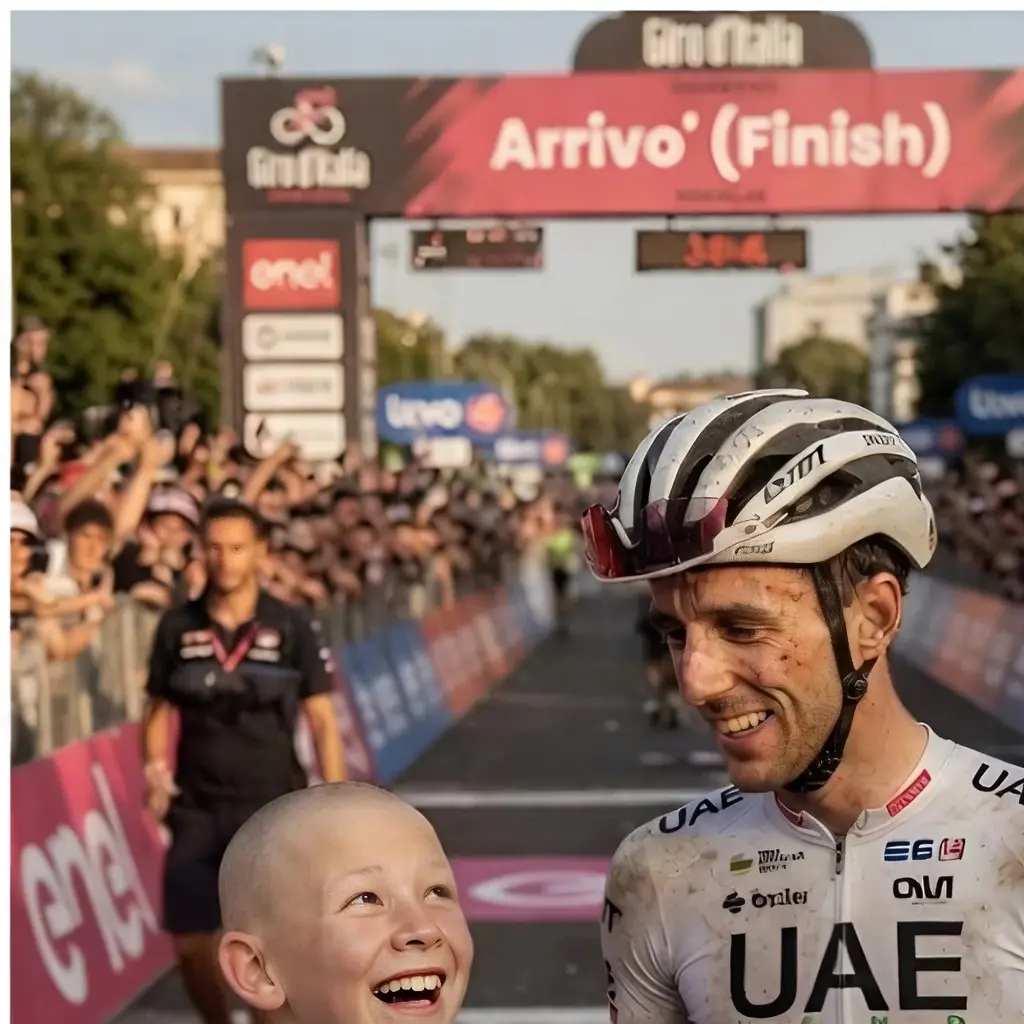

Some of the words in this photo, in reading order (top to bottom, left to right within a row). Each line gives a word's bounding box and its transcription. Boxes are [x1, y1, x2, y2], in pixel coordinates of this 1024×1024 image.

[711, 102, 950, 182] (Finish)
[659, 786, 744, 834] UAE
[730, 921, 968, 1019] UAE
